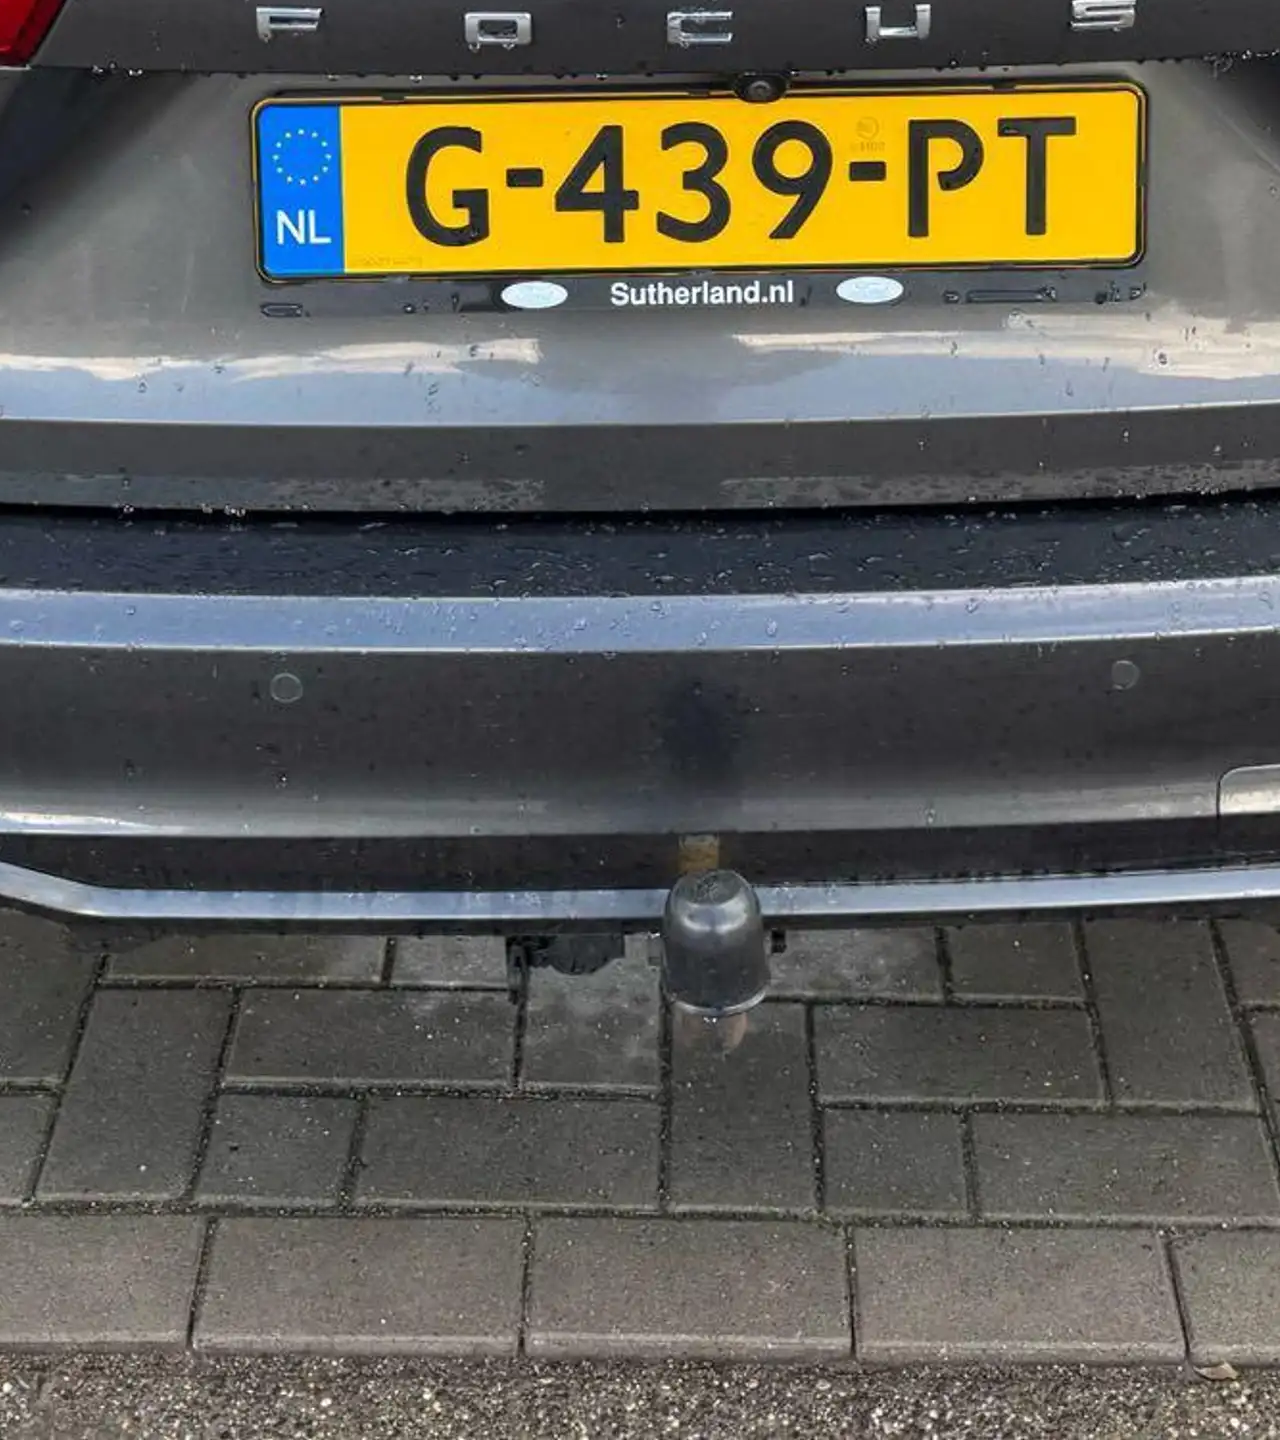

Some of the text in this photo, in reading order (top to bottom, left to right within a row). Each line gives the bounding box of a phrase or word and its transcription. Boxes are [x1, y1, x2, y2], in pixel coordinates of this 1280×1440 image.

[405, 116, 1077, 247] G-439-PT
[276, 209, 332, 245] NL
[610, 280, 795, 306] Sutherland.nl
